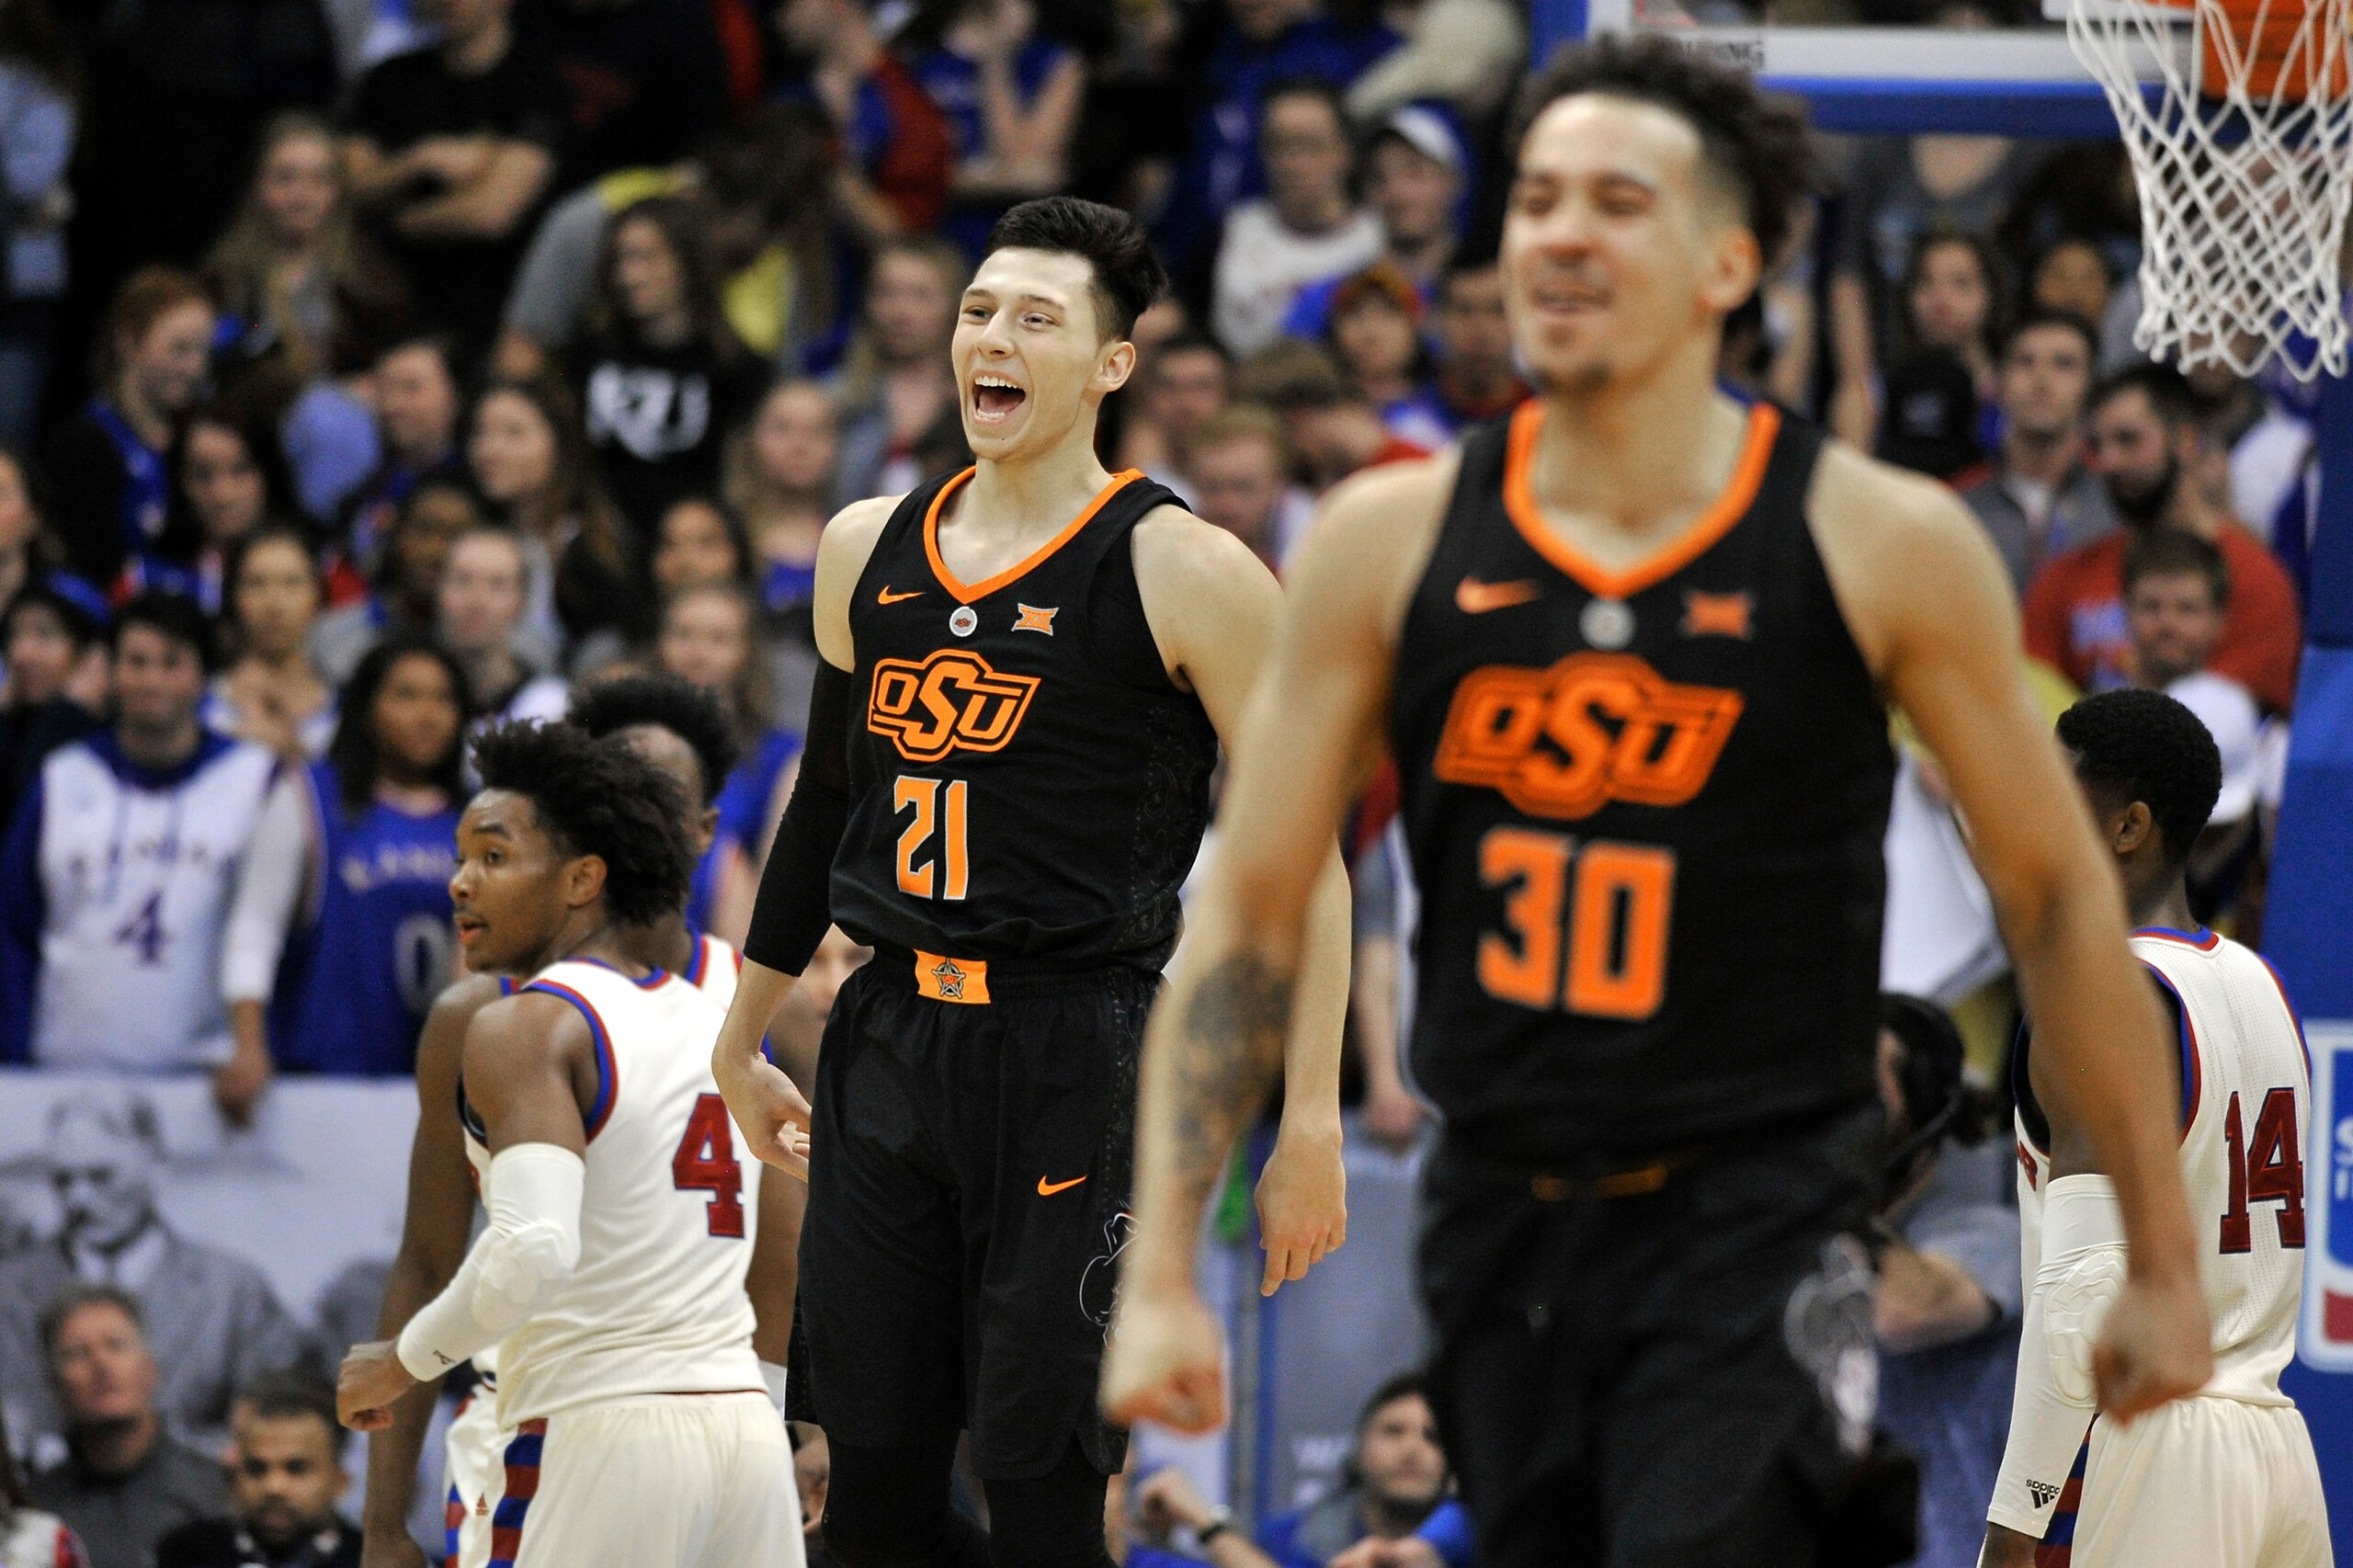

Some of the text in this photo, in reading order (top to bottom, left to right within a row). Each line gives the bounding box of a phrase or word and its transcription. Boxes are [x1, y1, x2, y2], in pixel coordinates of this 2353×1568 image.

[870, 652, 1037, 759] OSU
[1437, 655, 1739, 815] OSU
[893, 775, 969, 901] 21
[111, 888, 174, 968] 4
[1477, 826, 1676, 1022] 30
[672, 1092, 745, 1239] 4
[2219, 1086, 2306, 1255] 14
